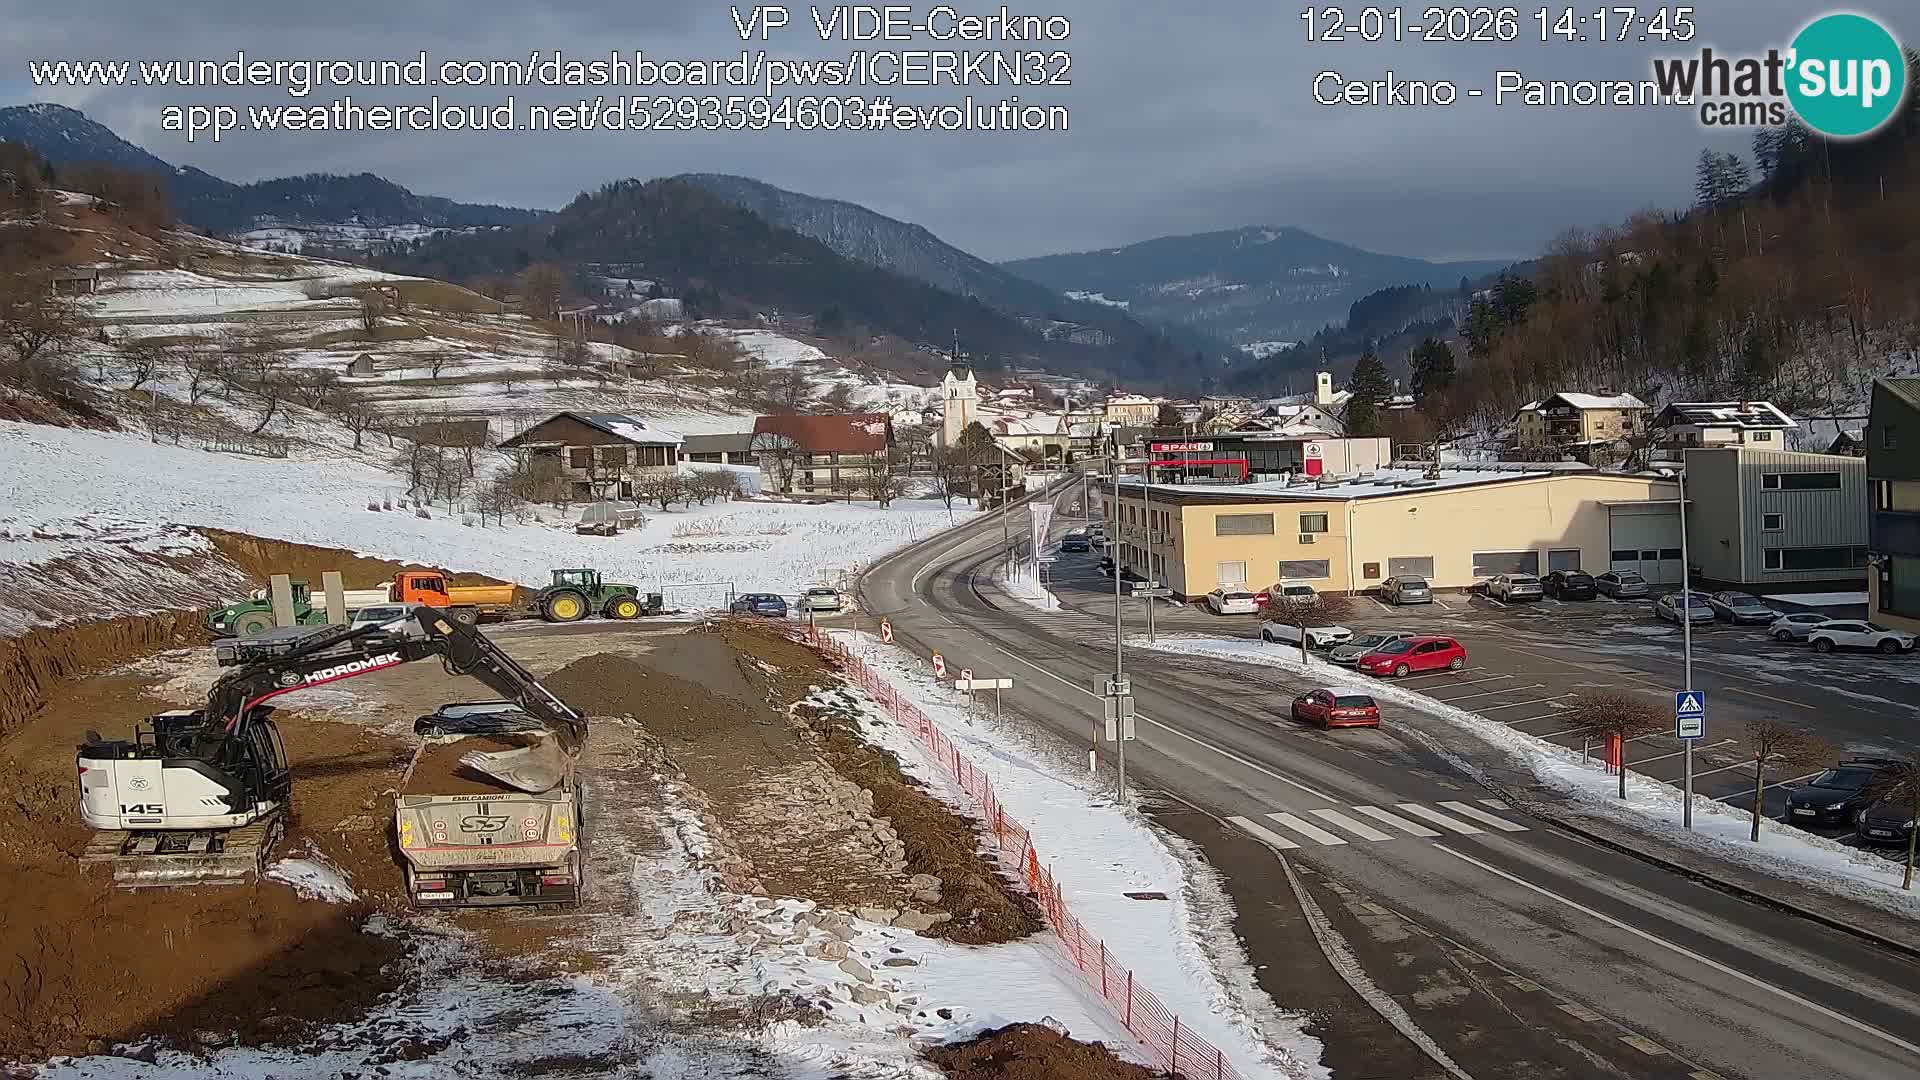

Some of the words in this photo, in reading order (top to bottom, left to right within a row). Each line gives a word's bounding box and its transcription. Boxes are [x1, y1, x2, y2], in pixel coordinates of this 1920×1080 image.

[1161, 443, 1198, 451] SPAR
[304, 651, 402, 683] HIDROMEK
[120, 804, 163, 814] 145
[460, 815, 511, 833] S5
